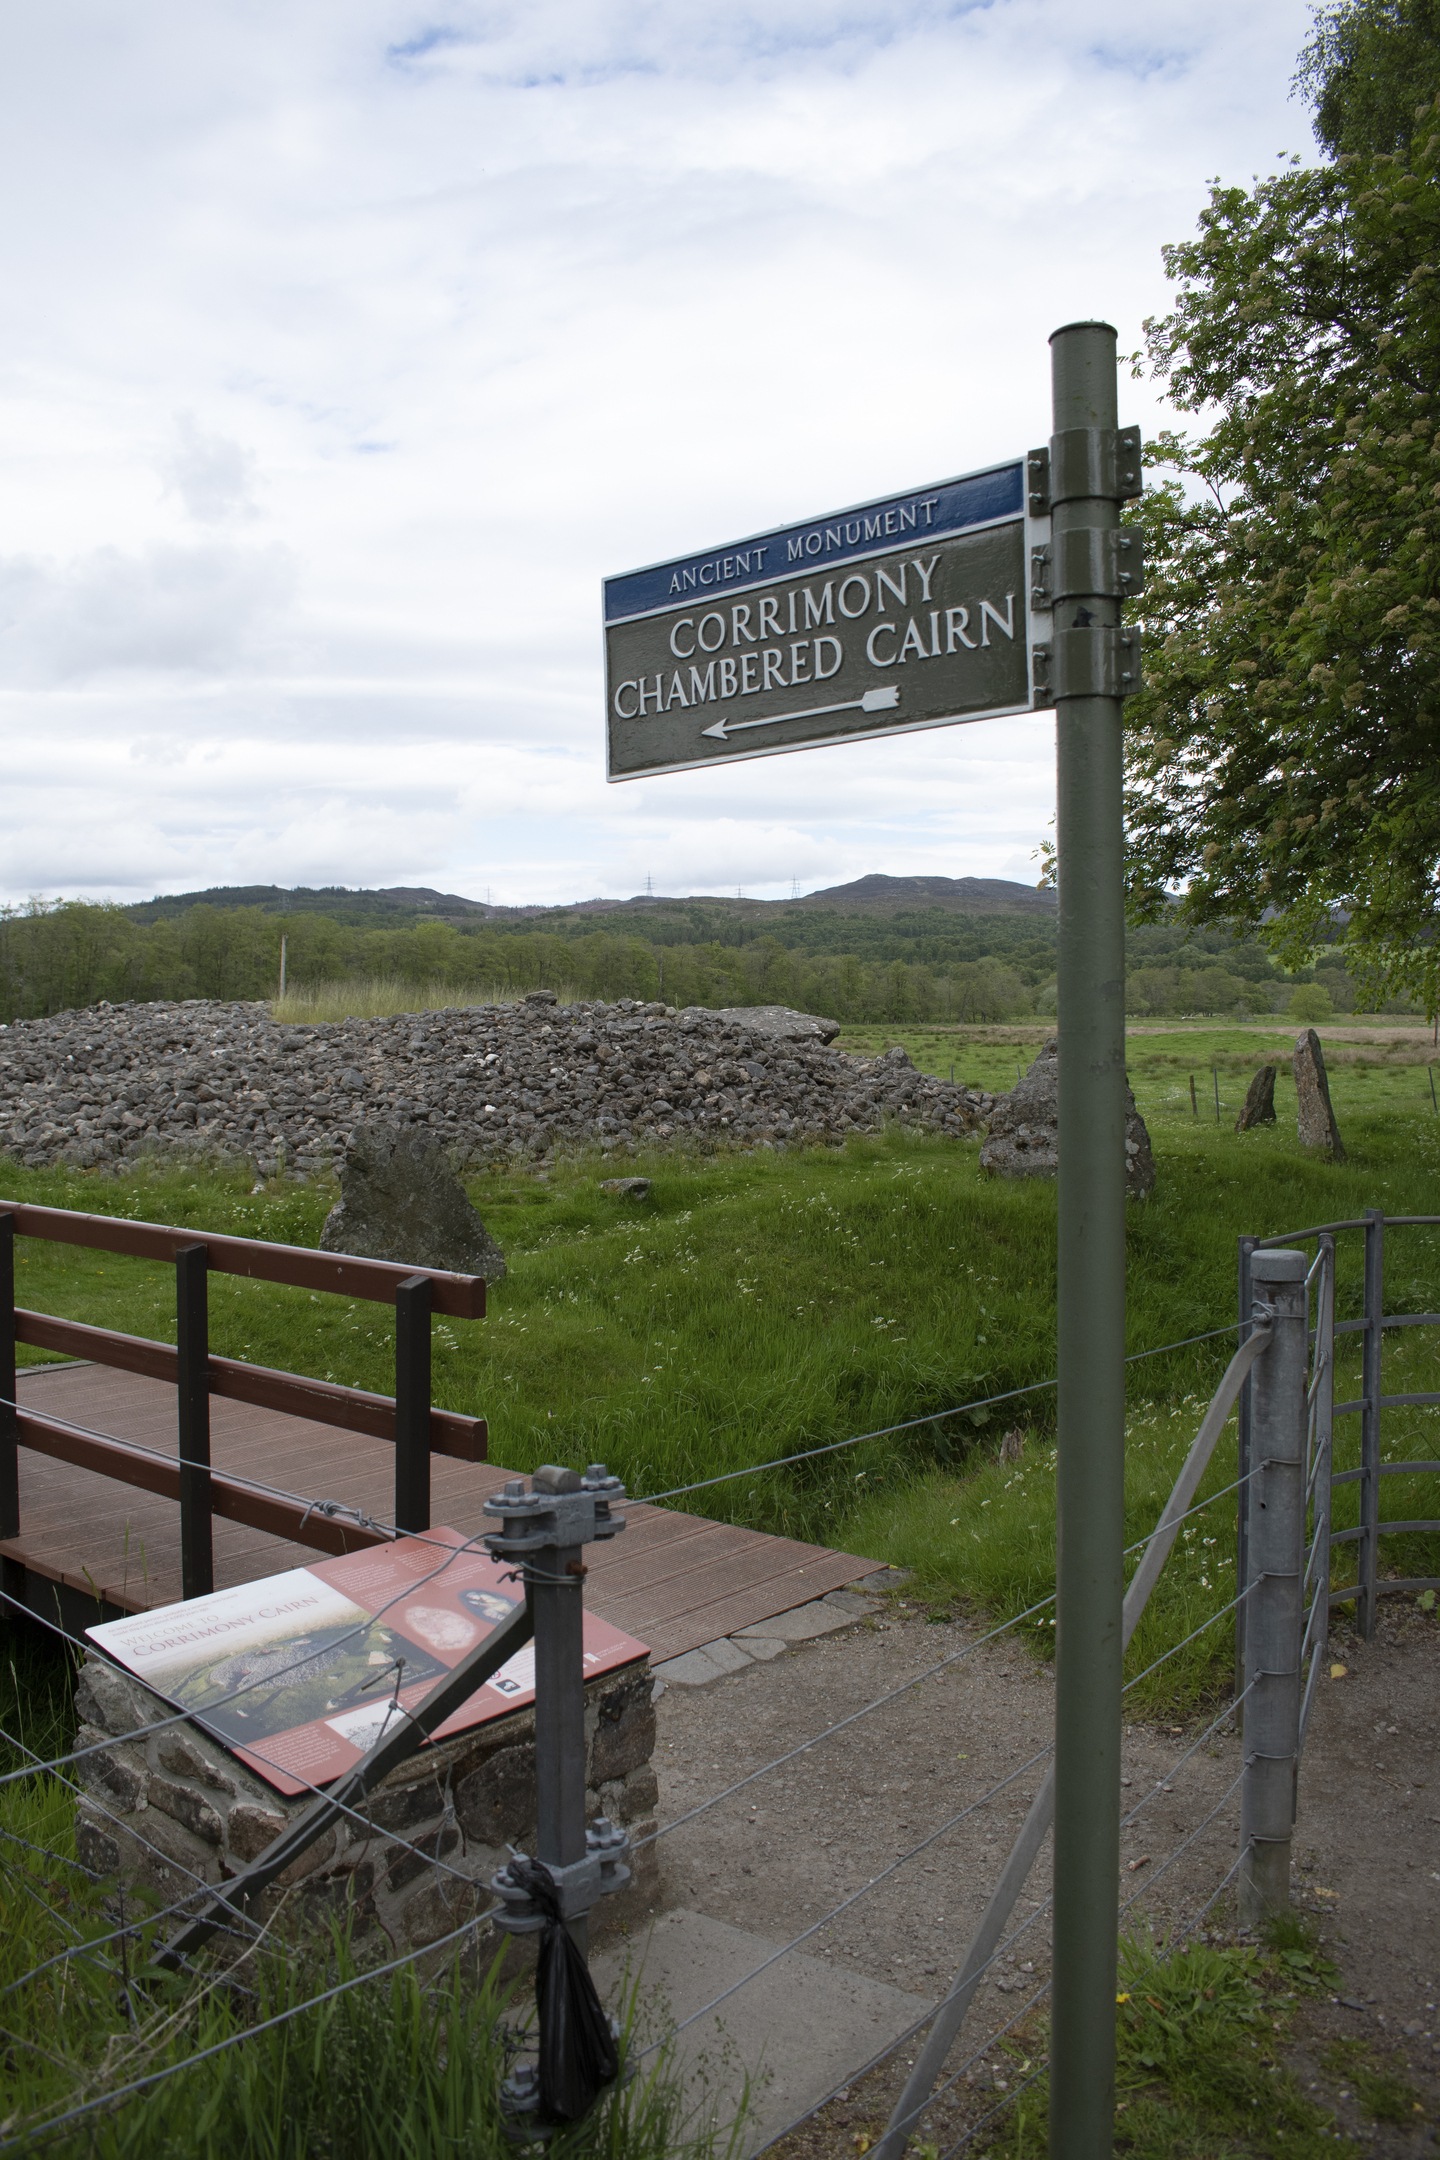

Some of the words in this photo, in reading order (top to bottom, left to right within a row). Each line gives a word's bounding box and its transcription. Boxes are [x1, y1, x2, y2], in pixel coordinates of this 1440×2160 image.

[669, 547, 768, 594] ANCIENT
[787, 499, 939, 562] MONUMENT
[670, 555, 942, 659] CORRIMONY
[614, 635, 844, 720] CHAMBERED
[866, 595, 1015, 668] CAIRN
[120, 1621, 197, 1646] WELCOME
[197, 1615, 219, 1625] TO
[133, 1615, 255, 1656] CORRIMONY
[258, 1596, 319, 1619] CAIRN
